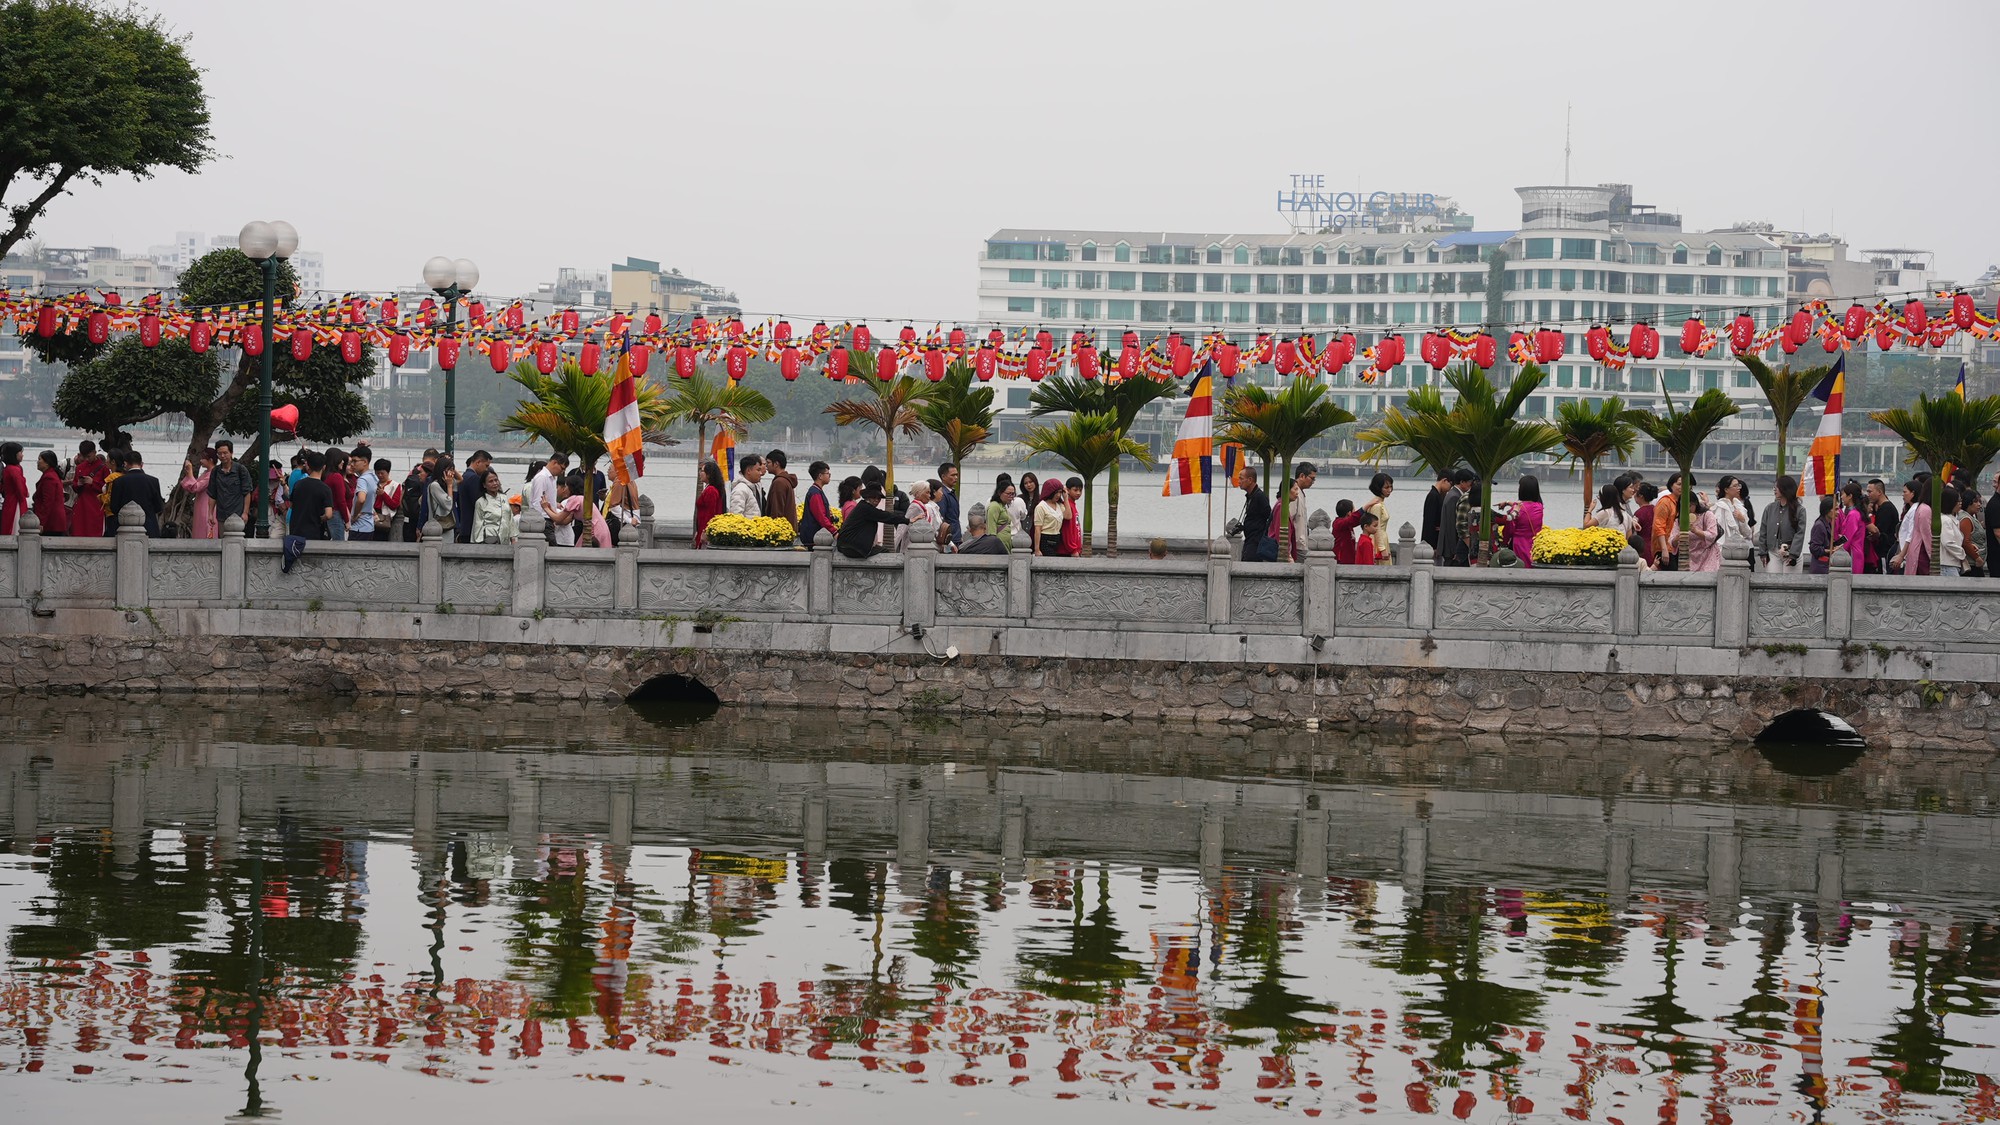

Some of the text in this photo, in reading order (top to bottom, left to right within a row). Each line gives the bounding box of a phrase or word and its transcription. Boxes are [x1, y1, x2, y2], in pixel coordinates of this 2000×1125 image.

[1290, 174, 1325, 188] THE
[1277, 190, 1438, 213] HANOI CLUB
[1320, 214, 1380, 229] HOTEL
